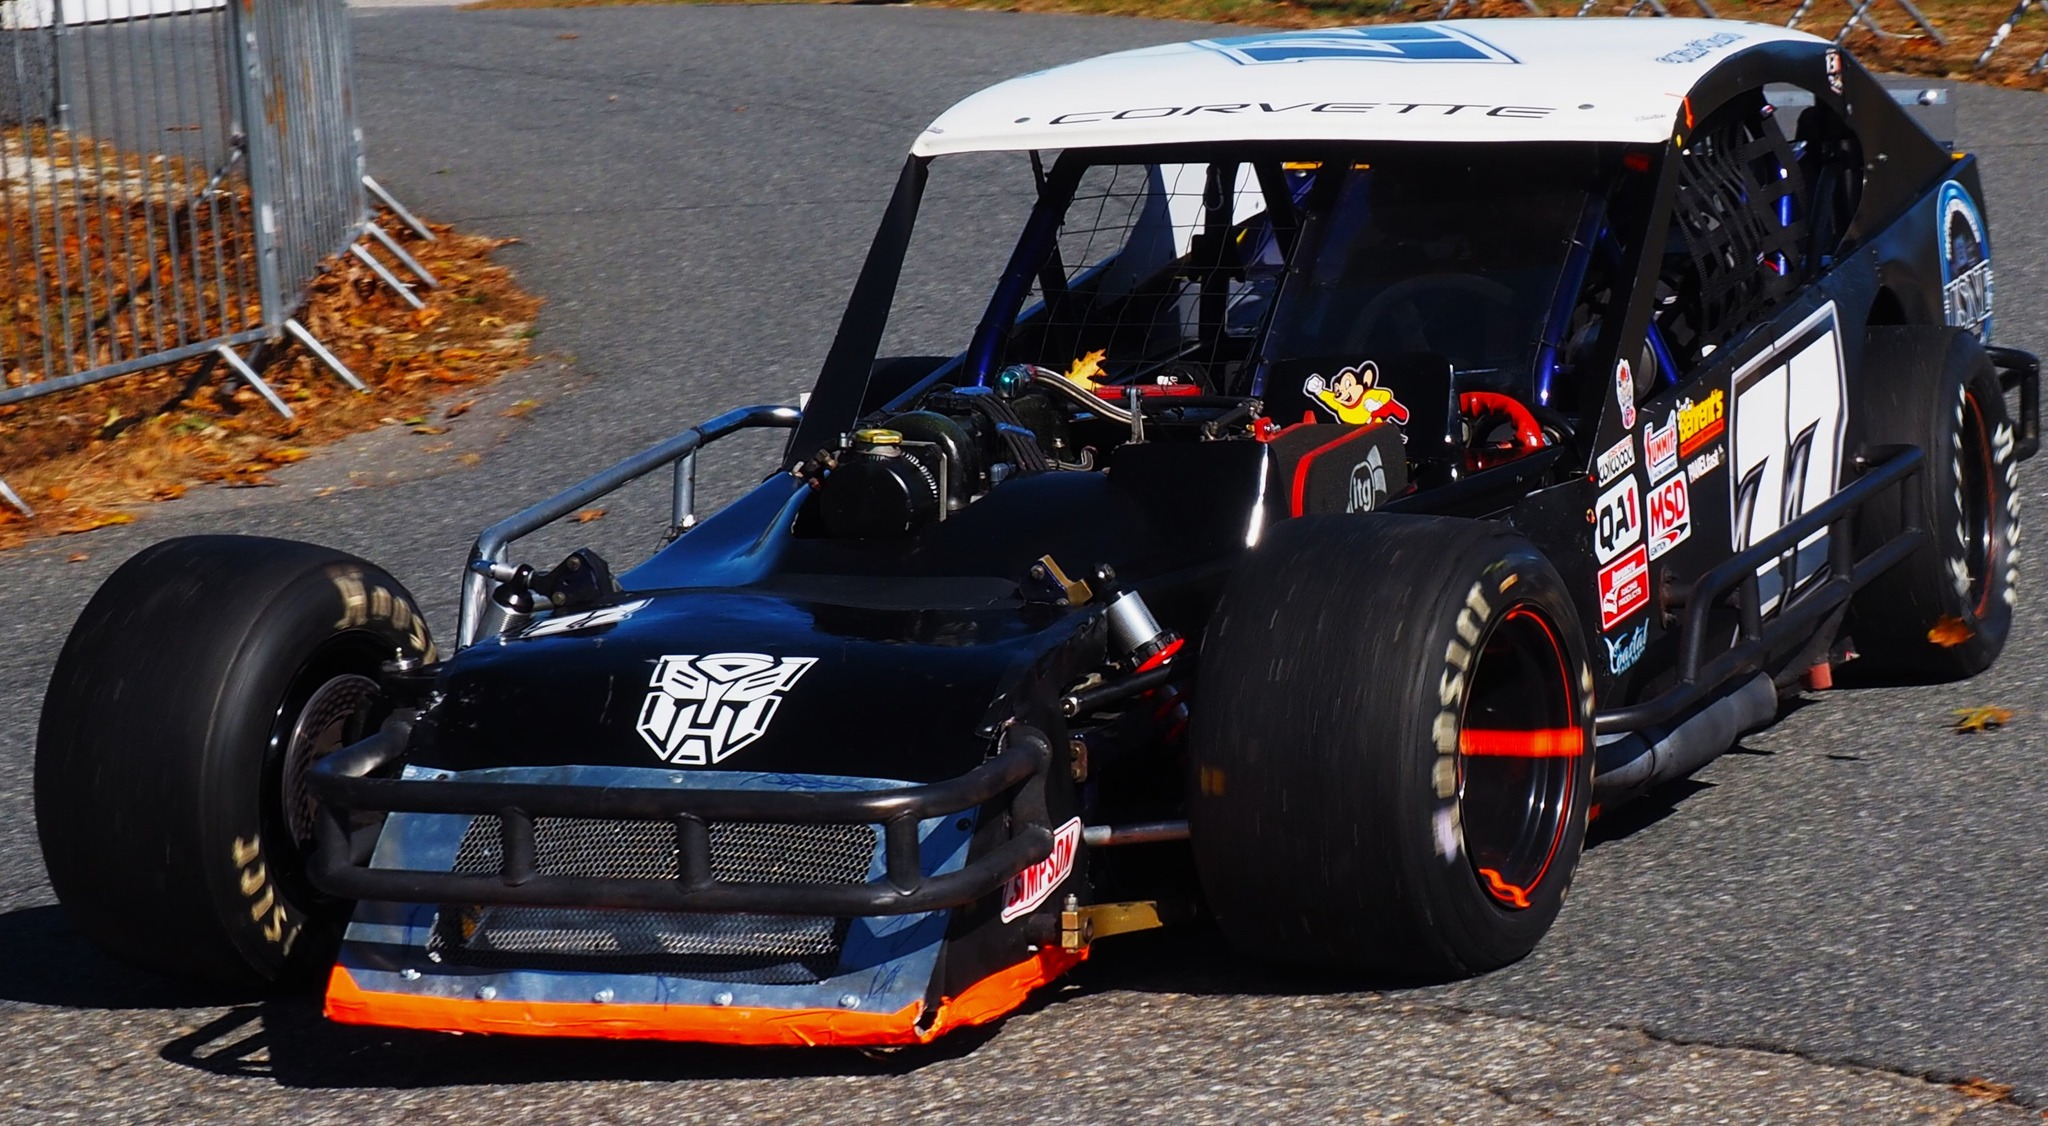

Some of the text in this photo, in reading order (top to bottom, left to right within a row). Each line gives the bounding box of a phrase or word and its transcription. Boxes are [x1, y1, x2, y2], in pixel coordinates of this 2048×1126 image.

[1047, 101, 1557, 125] CORVETTE
[1732, 303, 1848, 618] 77
[1352, 476, 1372, 512] itg
[1599, 486, 1637, 552] QA1
[1650, 479, 1686, 538] MSD
[1603, 617, 1650, 675] Coastal
[1007, 830, 1075, 908] SIMPSON
